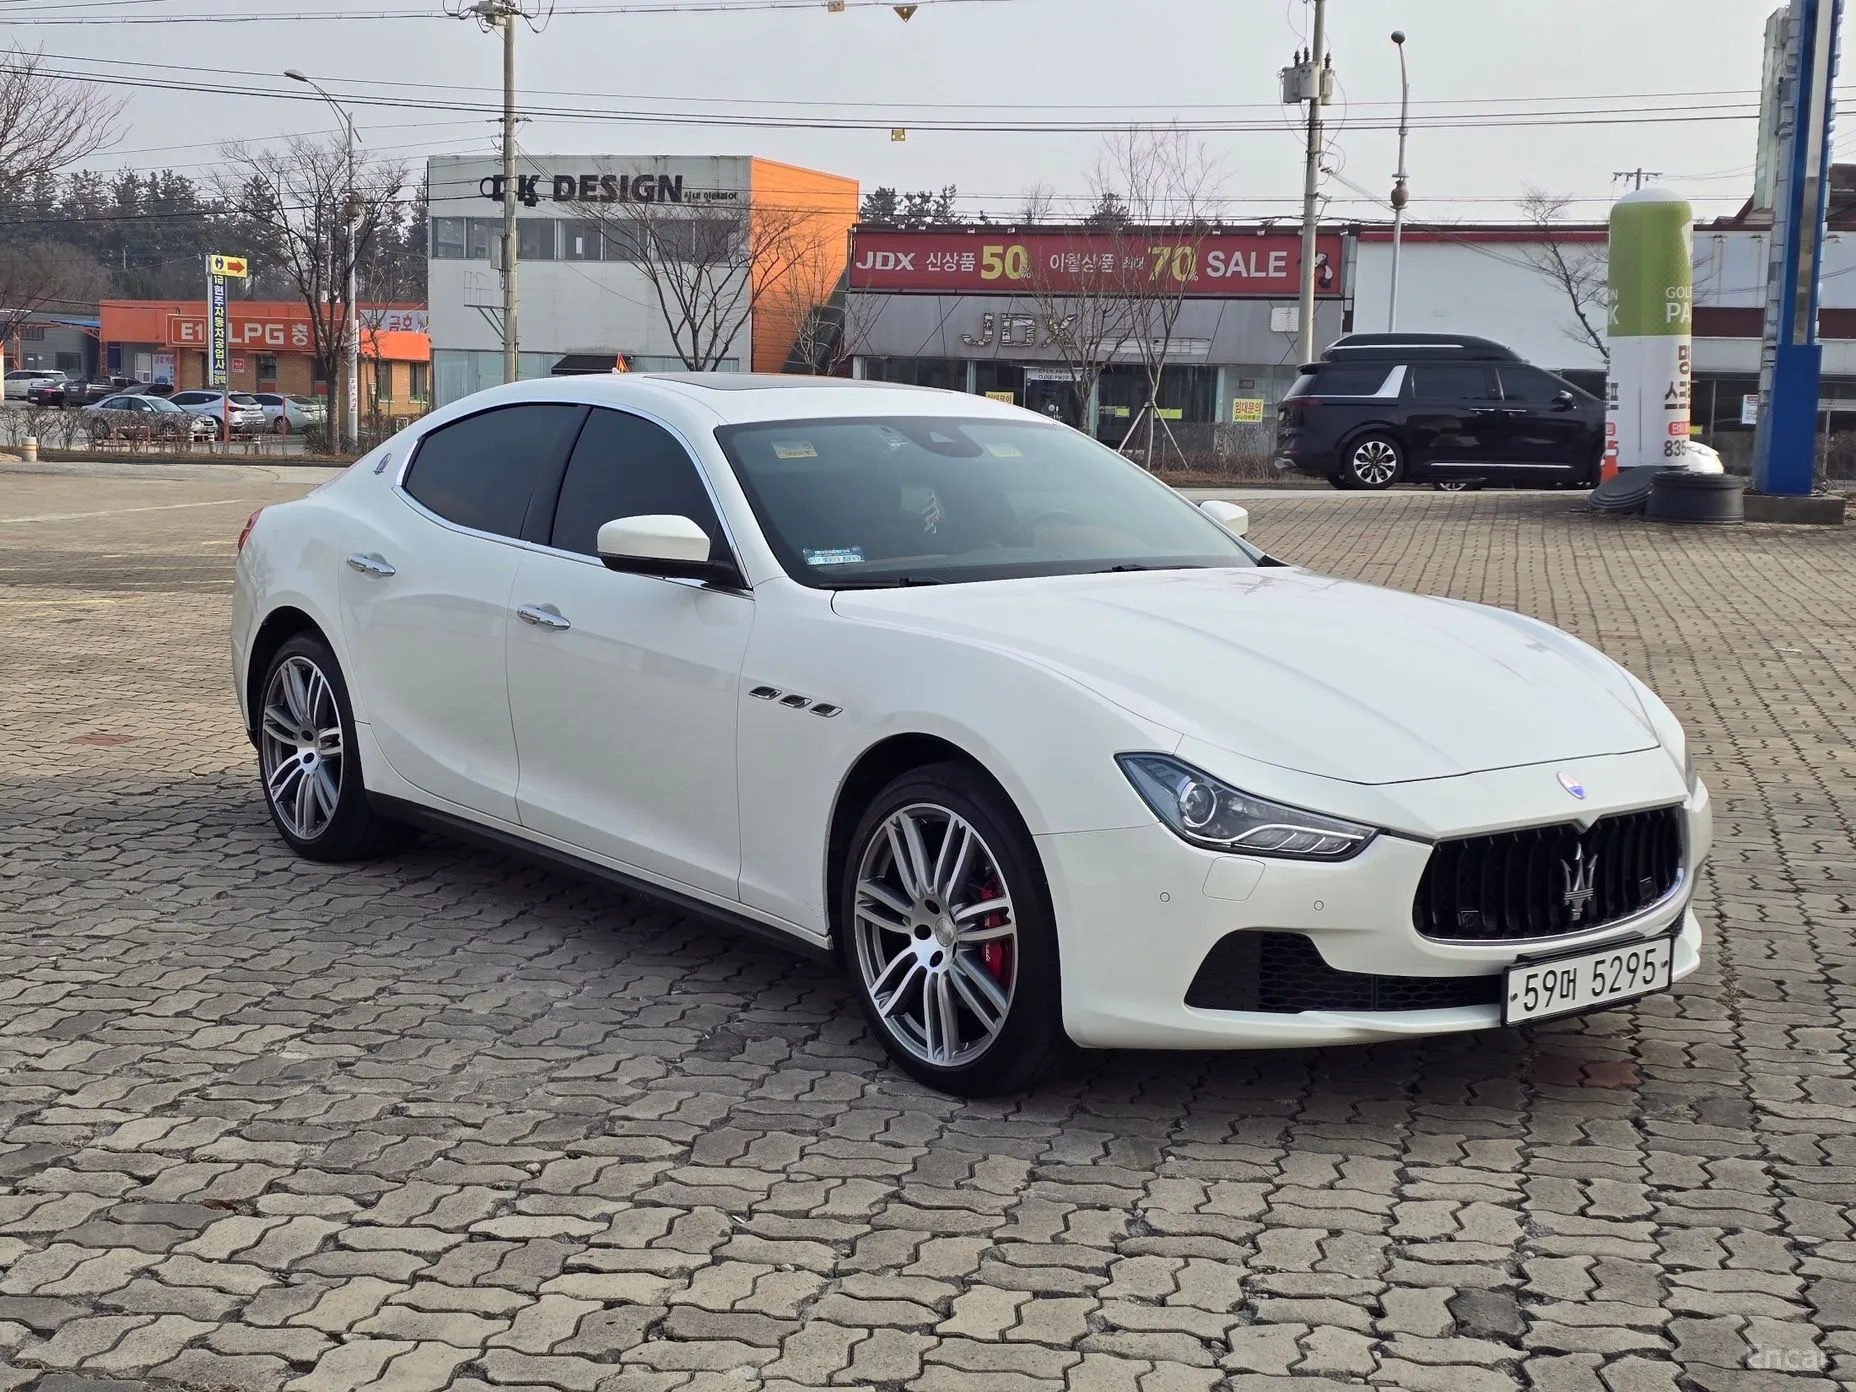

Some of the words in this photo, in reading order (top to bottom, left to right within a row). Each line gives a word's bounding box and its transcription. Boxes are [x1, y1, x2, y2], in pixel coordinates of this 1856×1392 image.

[552, 174, 683, 202] DESIGN
[856, 251, 915, 270] JDX
[926, 251, 976, 272] 신상품
[1049, 252, 1114, 273] 이월상품
[1206, 250, 1288, 278] SALE
[180, 322, 203, 341] E1
[227, 323, 284, 345] LPG
[961, 312, 1078, 349] JDX
[1235, 401, 1262, 415] 임대문의
[1523, 967, 1578, 1012] 59머
[1591, 948, 1657, 997] 5295
